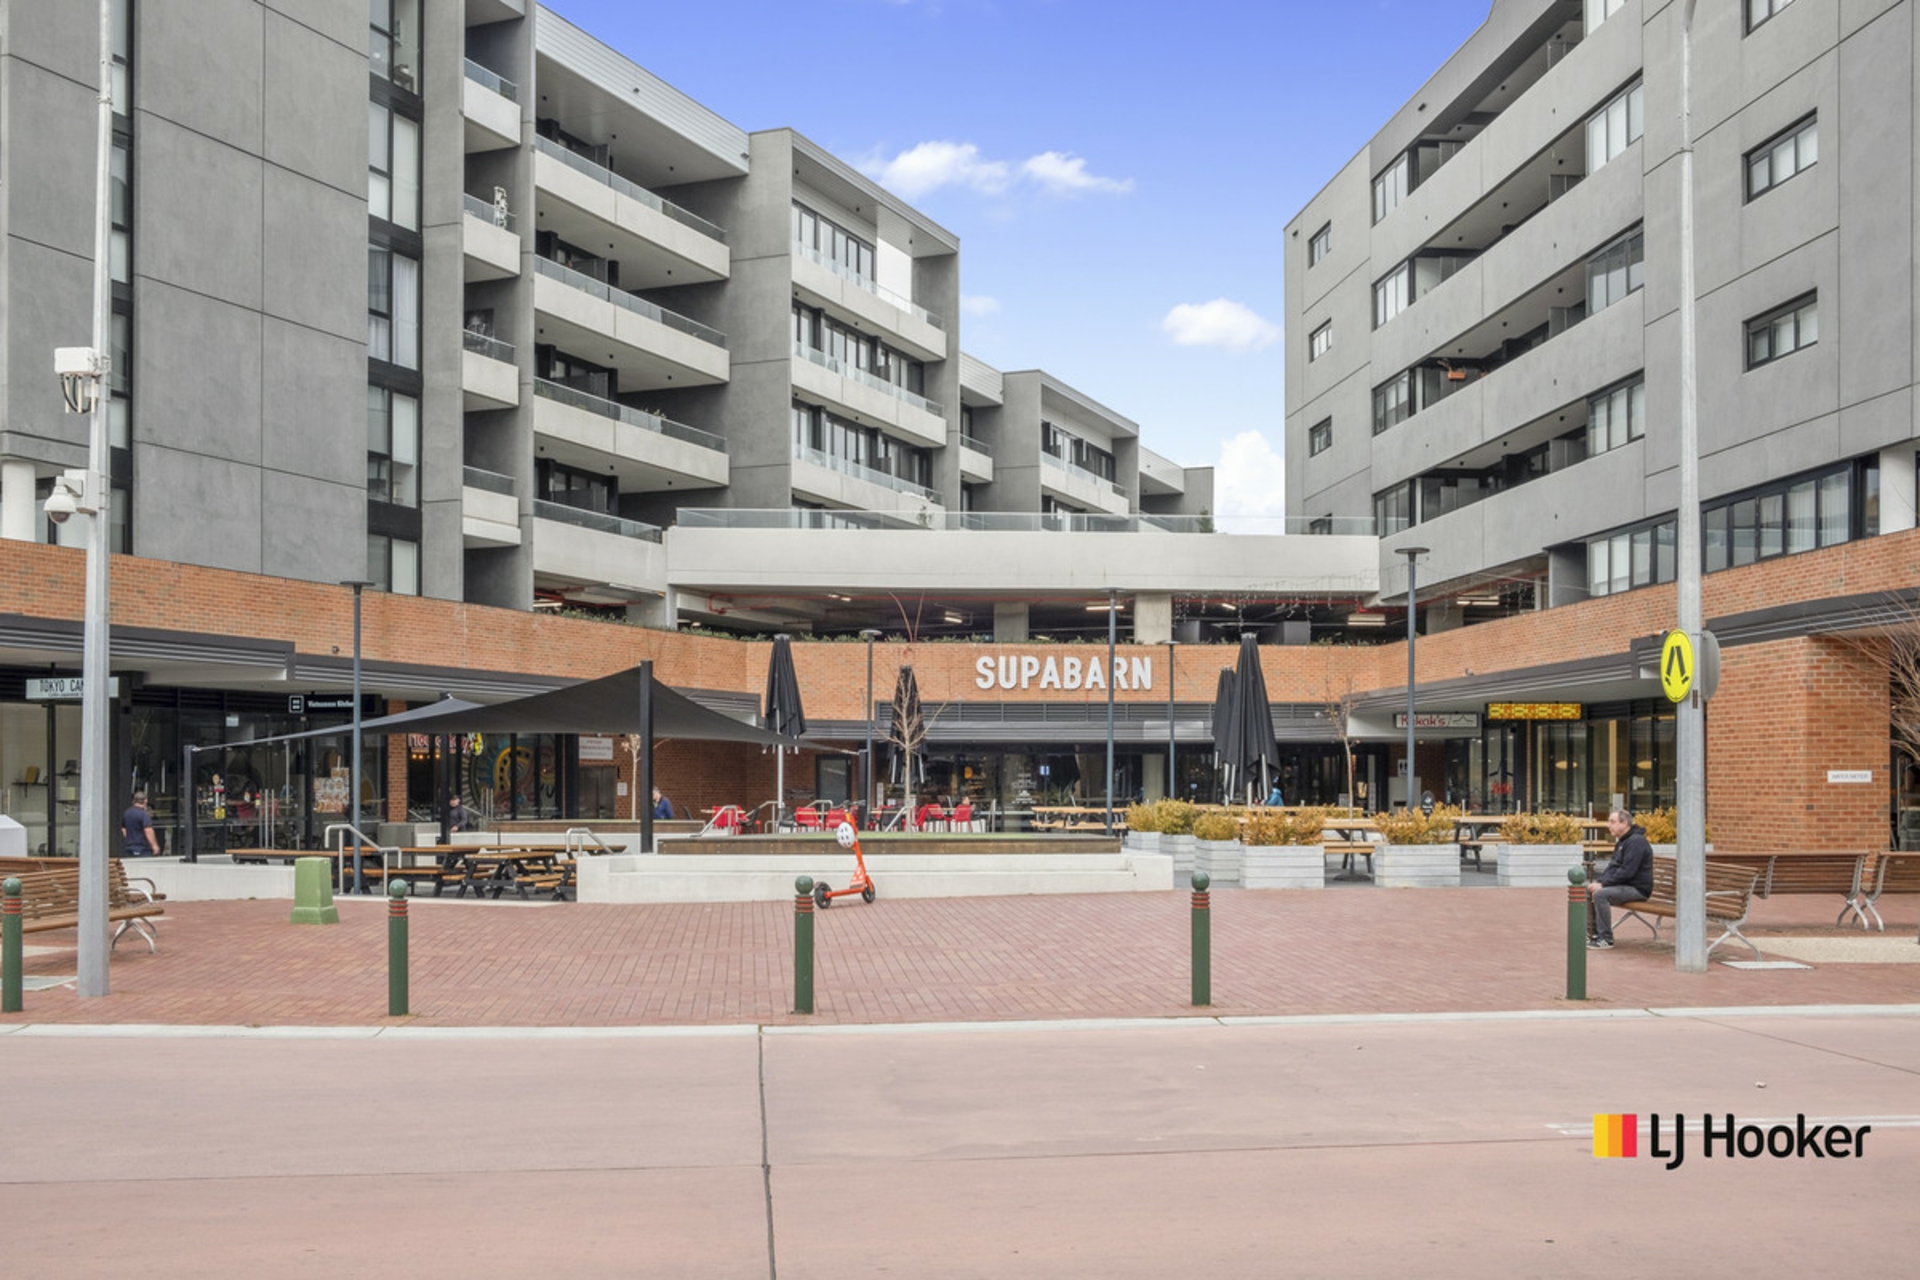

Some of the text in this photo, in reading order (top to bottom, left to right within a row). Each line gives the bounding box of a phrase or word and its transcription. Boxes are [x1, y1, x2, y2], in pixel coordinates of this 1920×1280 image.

[975, 655, 1152, 690] SUPABARN
[39, 679, 65, 692] TOKYO
[1401, 714, 1446, 727] Kkak's
